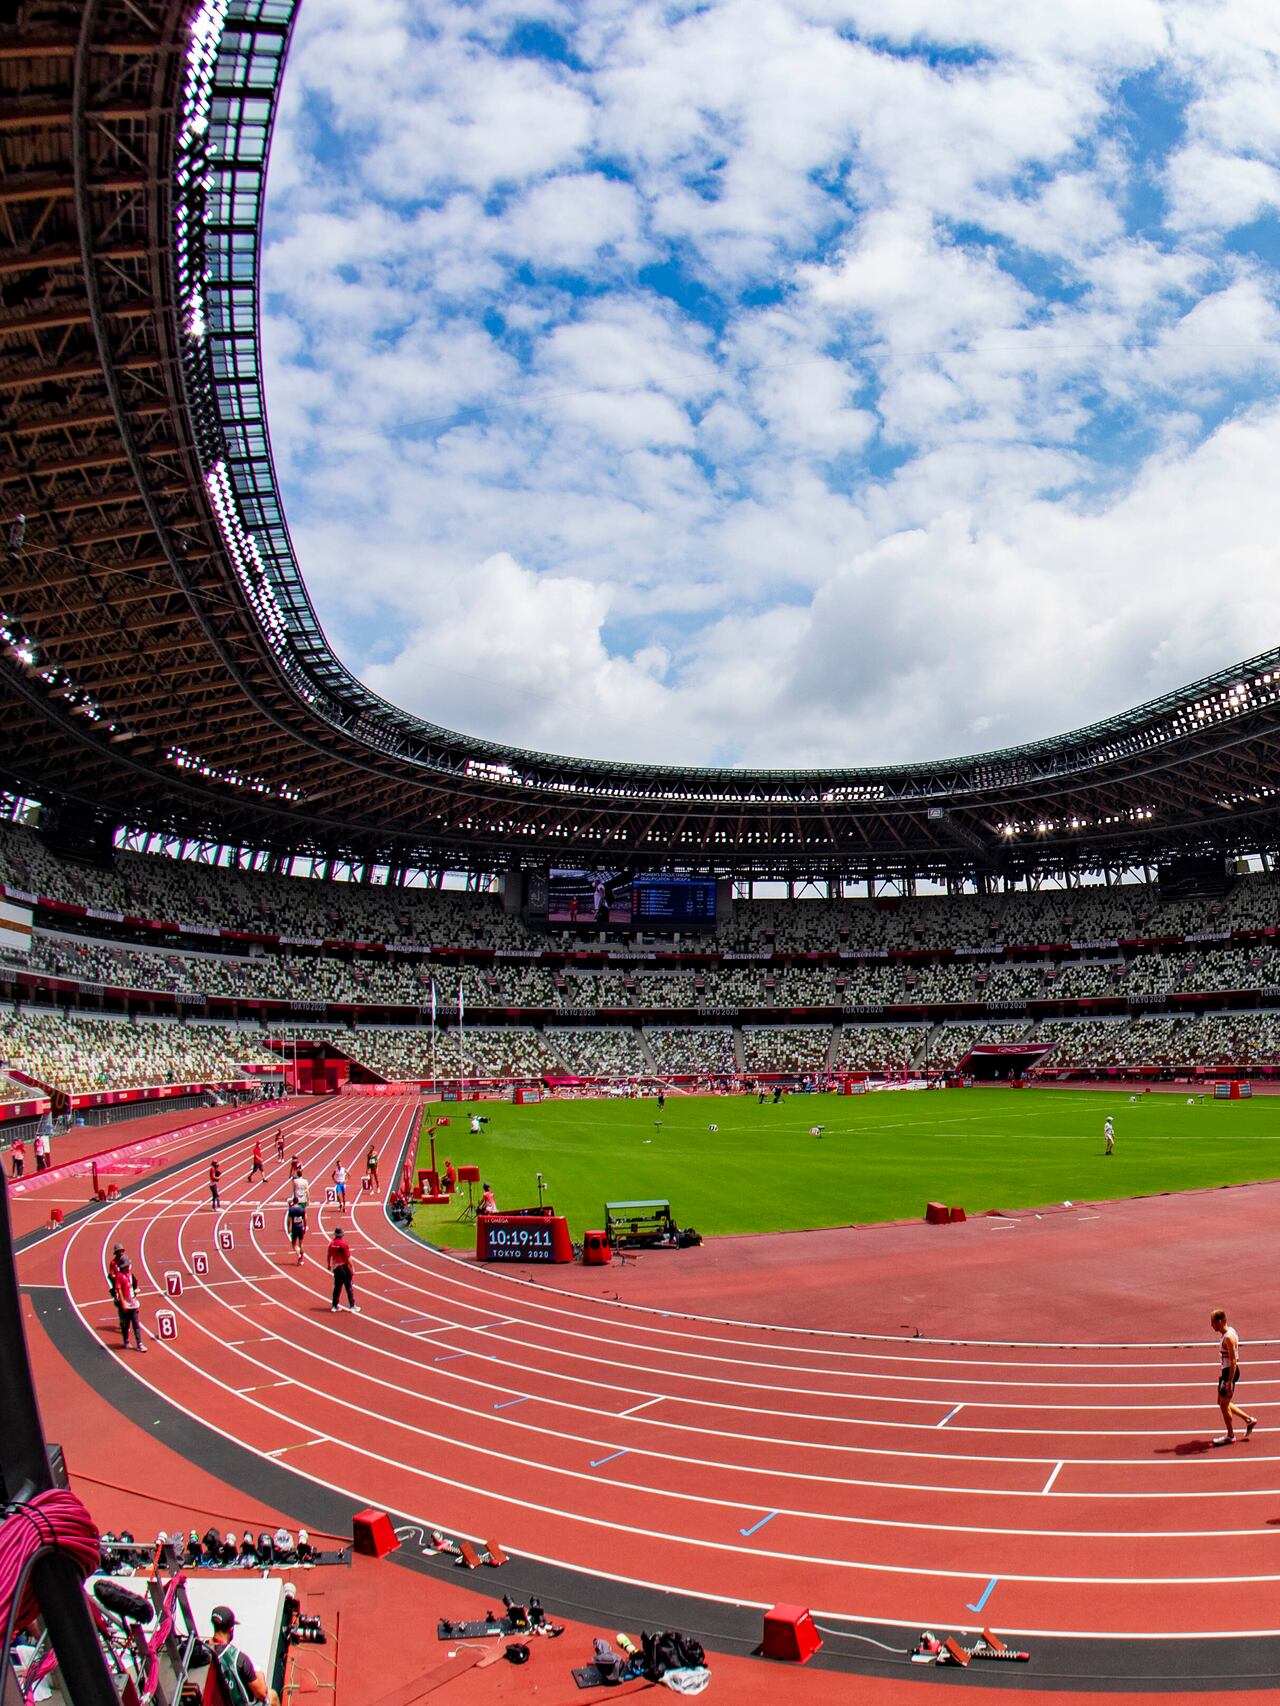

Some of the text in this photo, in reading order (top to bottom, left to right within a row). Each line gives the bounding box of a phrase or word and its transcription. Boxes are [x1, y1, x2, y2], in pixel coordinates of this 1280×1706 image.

[1126, 995, 1167, 1004] TOKYO 2020
[290, 1002, 327, 1011] TOKYO 2020
[419, 1006, 458, 1015] TOKO 2020
[842, 1006, 865, 1014] TOKYO
[986, 1001, 1027, 1010] TOKYO 2020
[579, 1008, 596, 1016] 2020
[364, 1179, 370, 1189] 1
[328, 1190, 334, 1200] 2
[255, 1216, 262, 1227] 4
[223, 1234, 230, 1247] 5
[489, 1230, 552, 1246] 10:19:11
[493, 1250, 549, 1258] TOKYO 2020
[197, 1259, 205, 1272] 6
[170, 1278, 178, 1293] 7
[163, 1318, 172, 1335] 8
